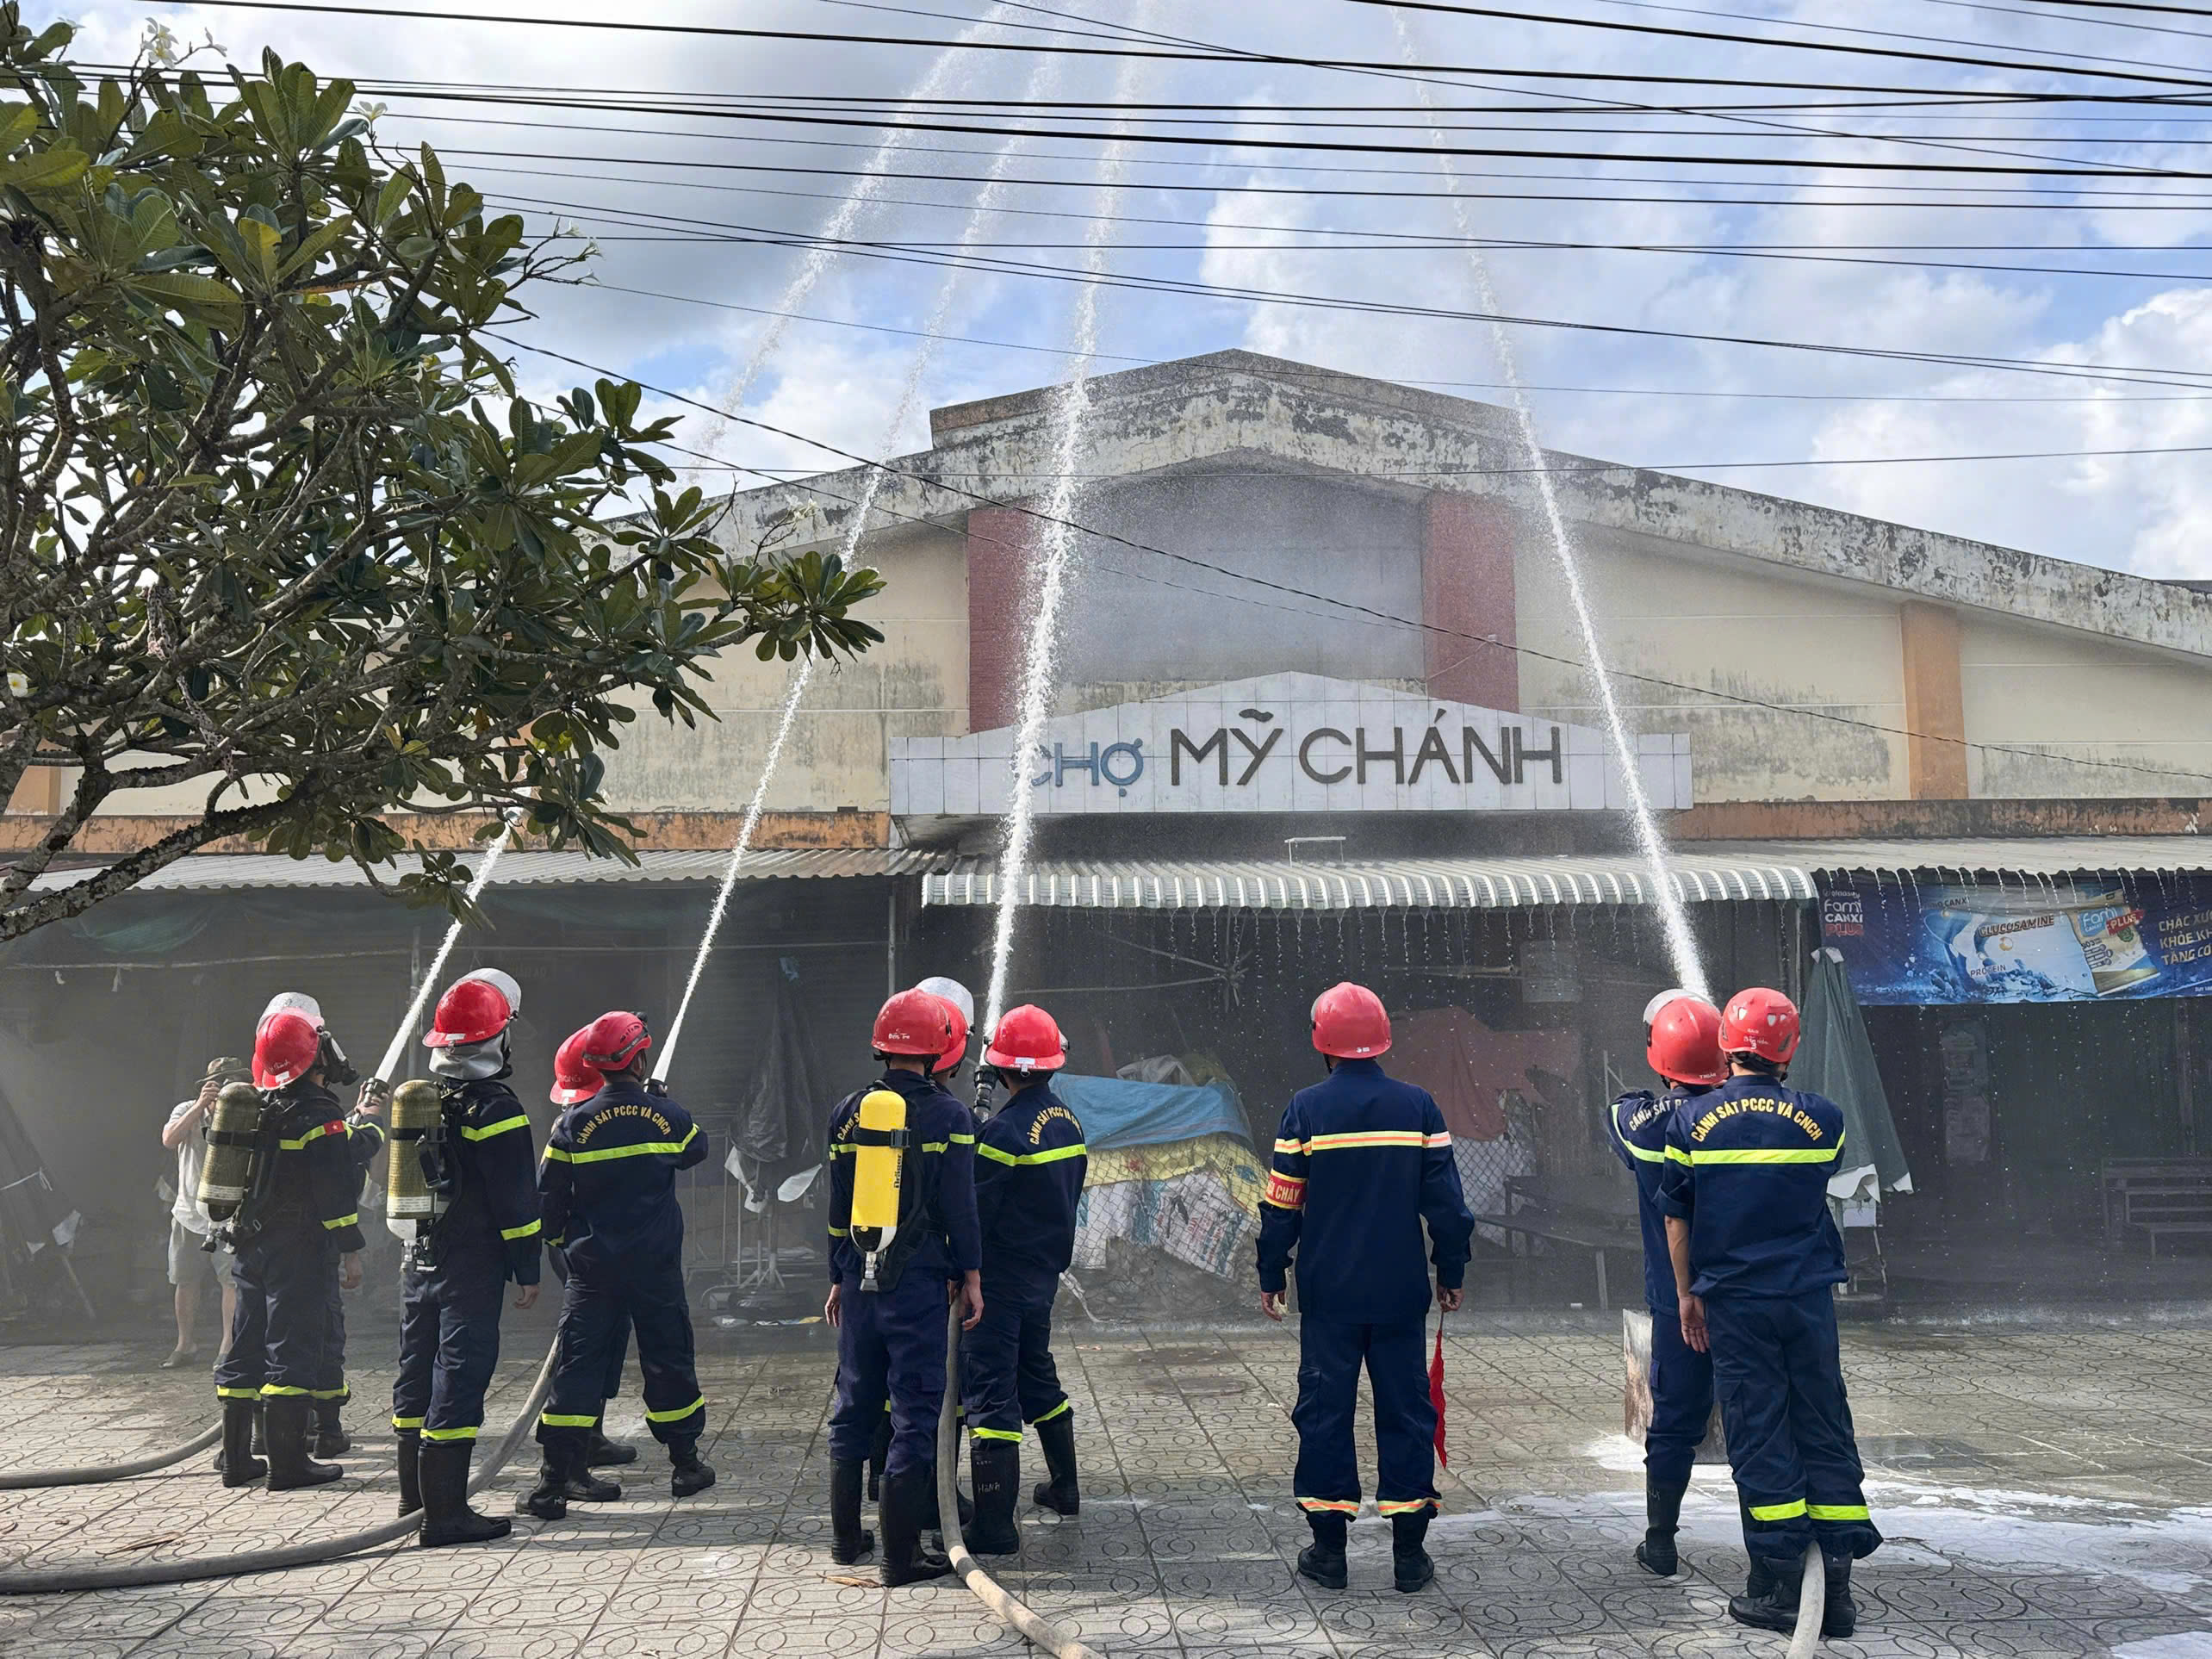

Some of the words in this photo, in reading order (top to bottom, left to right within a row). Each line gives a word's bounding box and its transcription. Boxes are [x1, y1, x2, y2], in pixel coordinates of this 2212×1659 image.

[1171, 708, 1283, 786] MỸ
[1298, 707, 1563, 786] CHÁNH
[1824, 913, 1863, 923] CANXI
[1980, 914, 2054, 937] GLUCOSAMINE
[2109, 913, 2137, 929] PLUS
[613, 1105, 638, 1117] PCCC
[652, 1112, 671, 1135] CNCH
[1691, 1111, 1719, 1142] CẢNH
[1716, 1101, 1740, 1119] SÁT
[1741, 1098, 1774, 1113] PCCC
[1776, 1102, 1793, 1118] VÀ
[1793, 1110, 1823, 1140] CNCH
